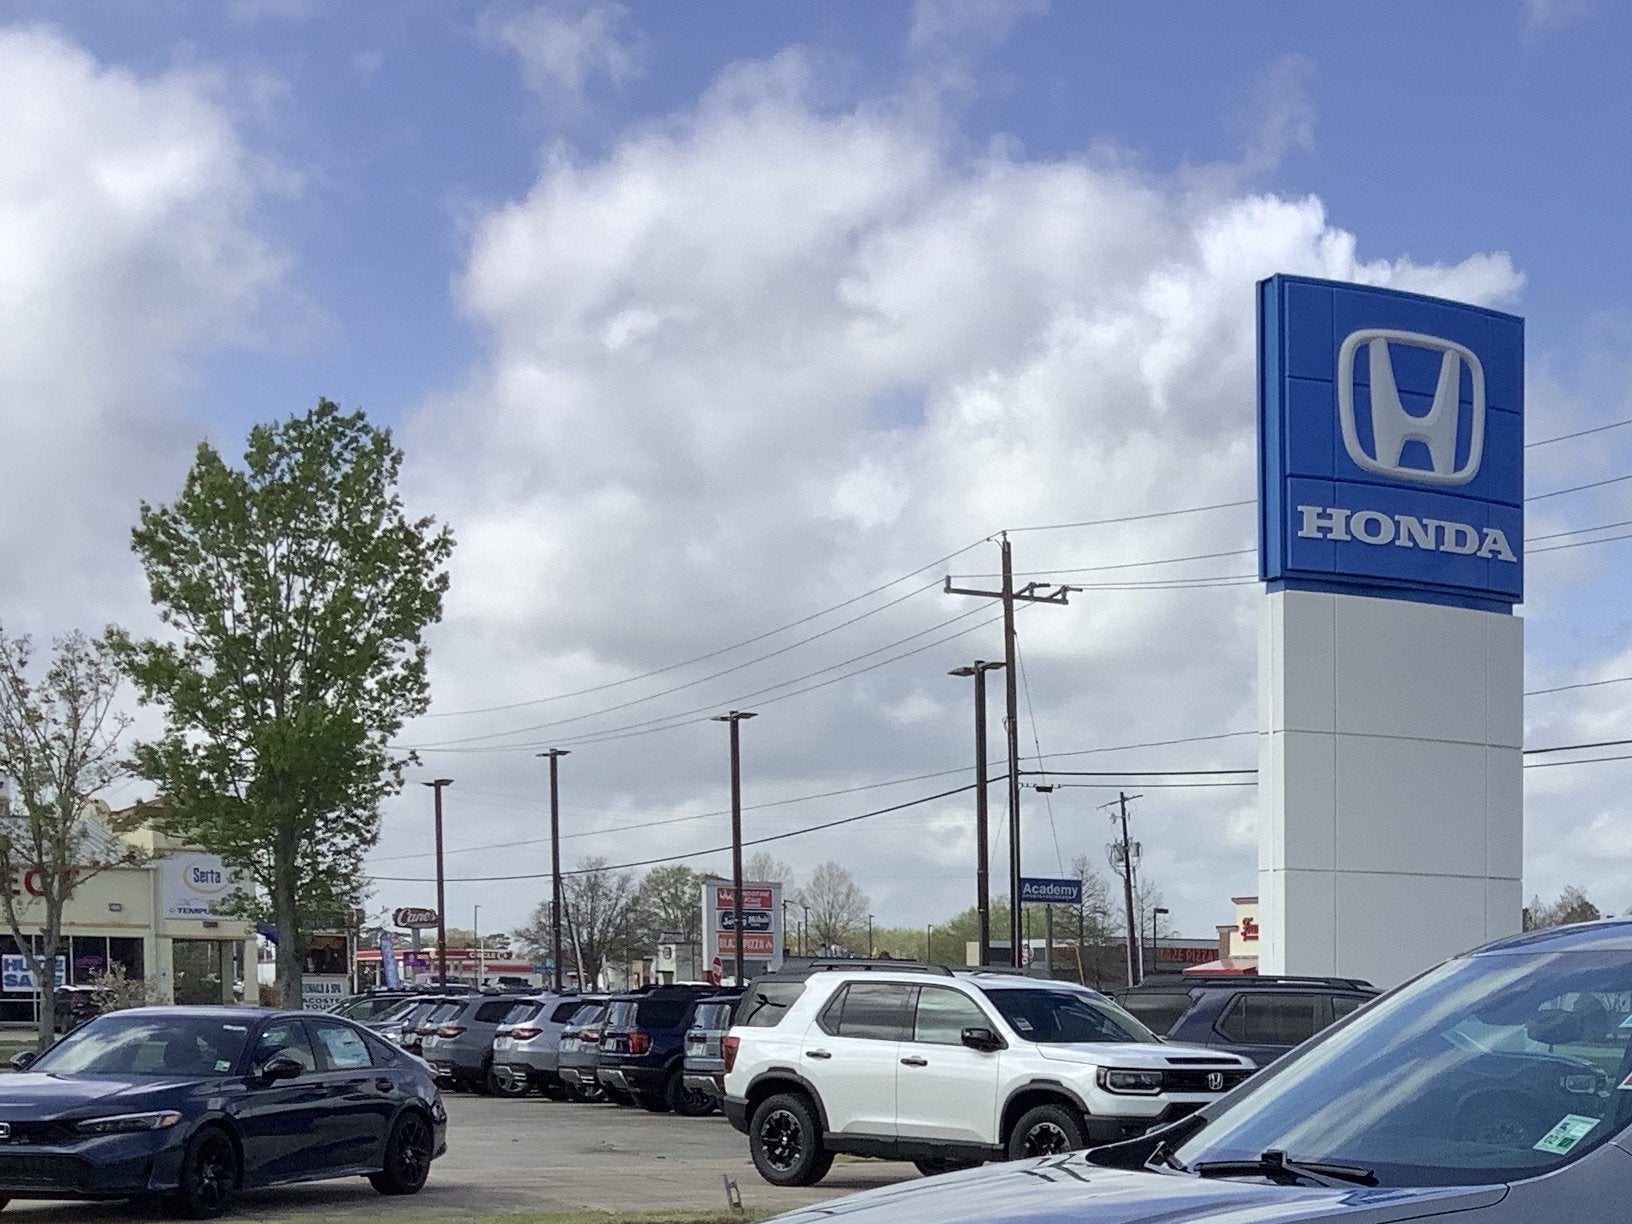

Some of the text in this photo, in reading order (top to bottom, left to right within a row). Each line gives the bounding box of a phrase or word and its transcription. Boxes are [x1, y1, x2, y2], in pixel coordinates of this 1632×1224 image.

[1297, 505, 1518, 563] HONDA
[193, 867, 221, 884] Serta
[1023, 883, 1079, 899] Academy
[5, 974, 63, 987] SAE
